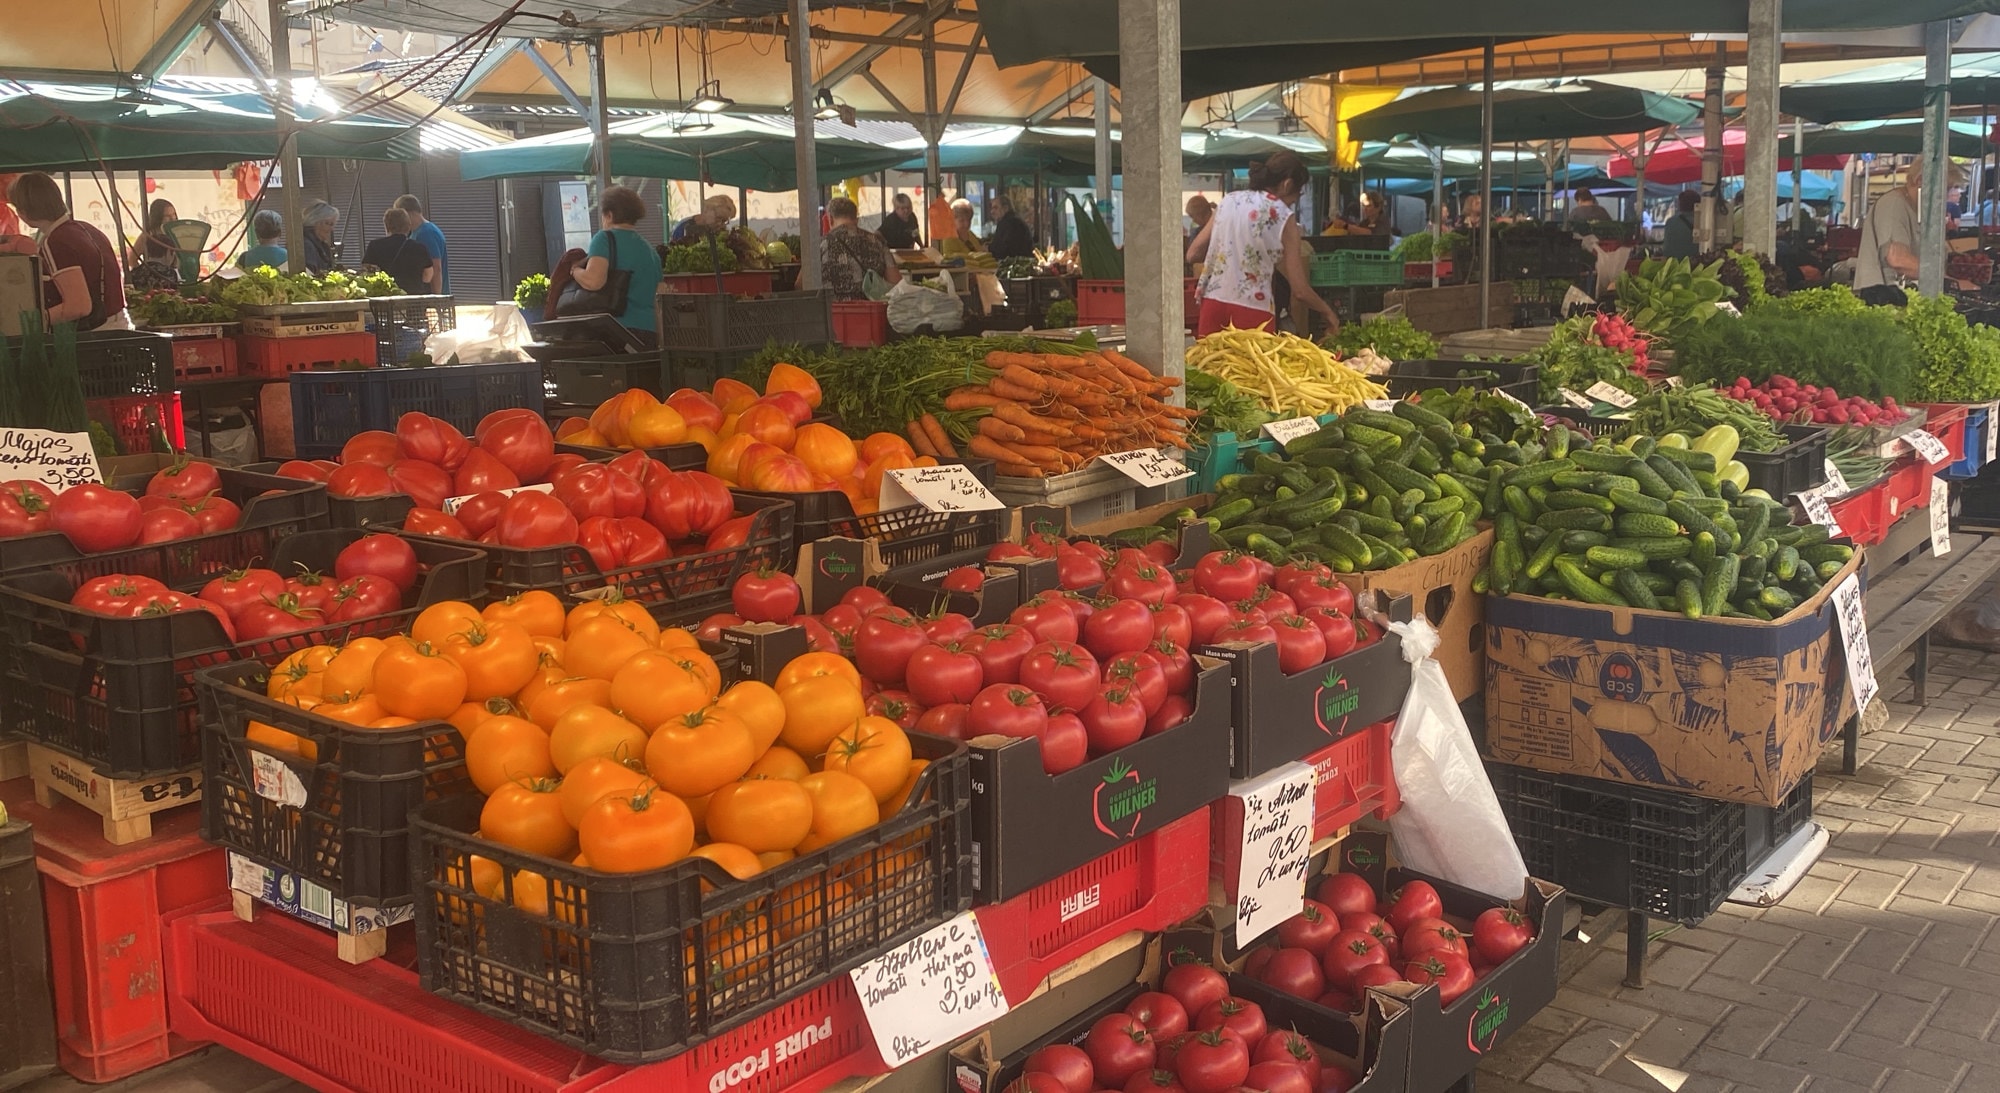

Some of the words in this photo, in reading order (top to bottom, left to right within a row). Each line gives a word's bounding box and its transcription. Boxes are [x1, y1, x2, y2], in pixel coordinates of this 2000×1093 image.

[306, 324, 340, 332] KING
[1205, 649, 1221, 657] Masa
[1221, 651, 1237, 659] netto
[741, 661, 752, 675] kg
[1606, 680, 1634, 694] SCB
[1325, 694, 1359, 721] WILNER
[50, 764, 89, 797] lahuerta
[971, 778, 984, 794] kg
[1109, 786, 1157, 823] WILNER
[1477, 1005, 1509, 1042] WILNER
[774, 1015, 833, 1064] PURE
[708, 1047, 770, 1093] FOOD
